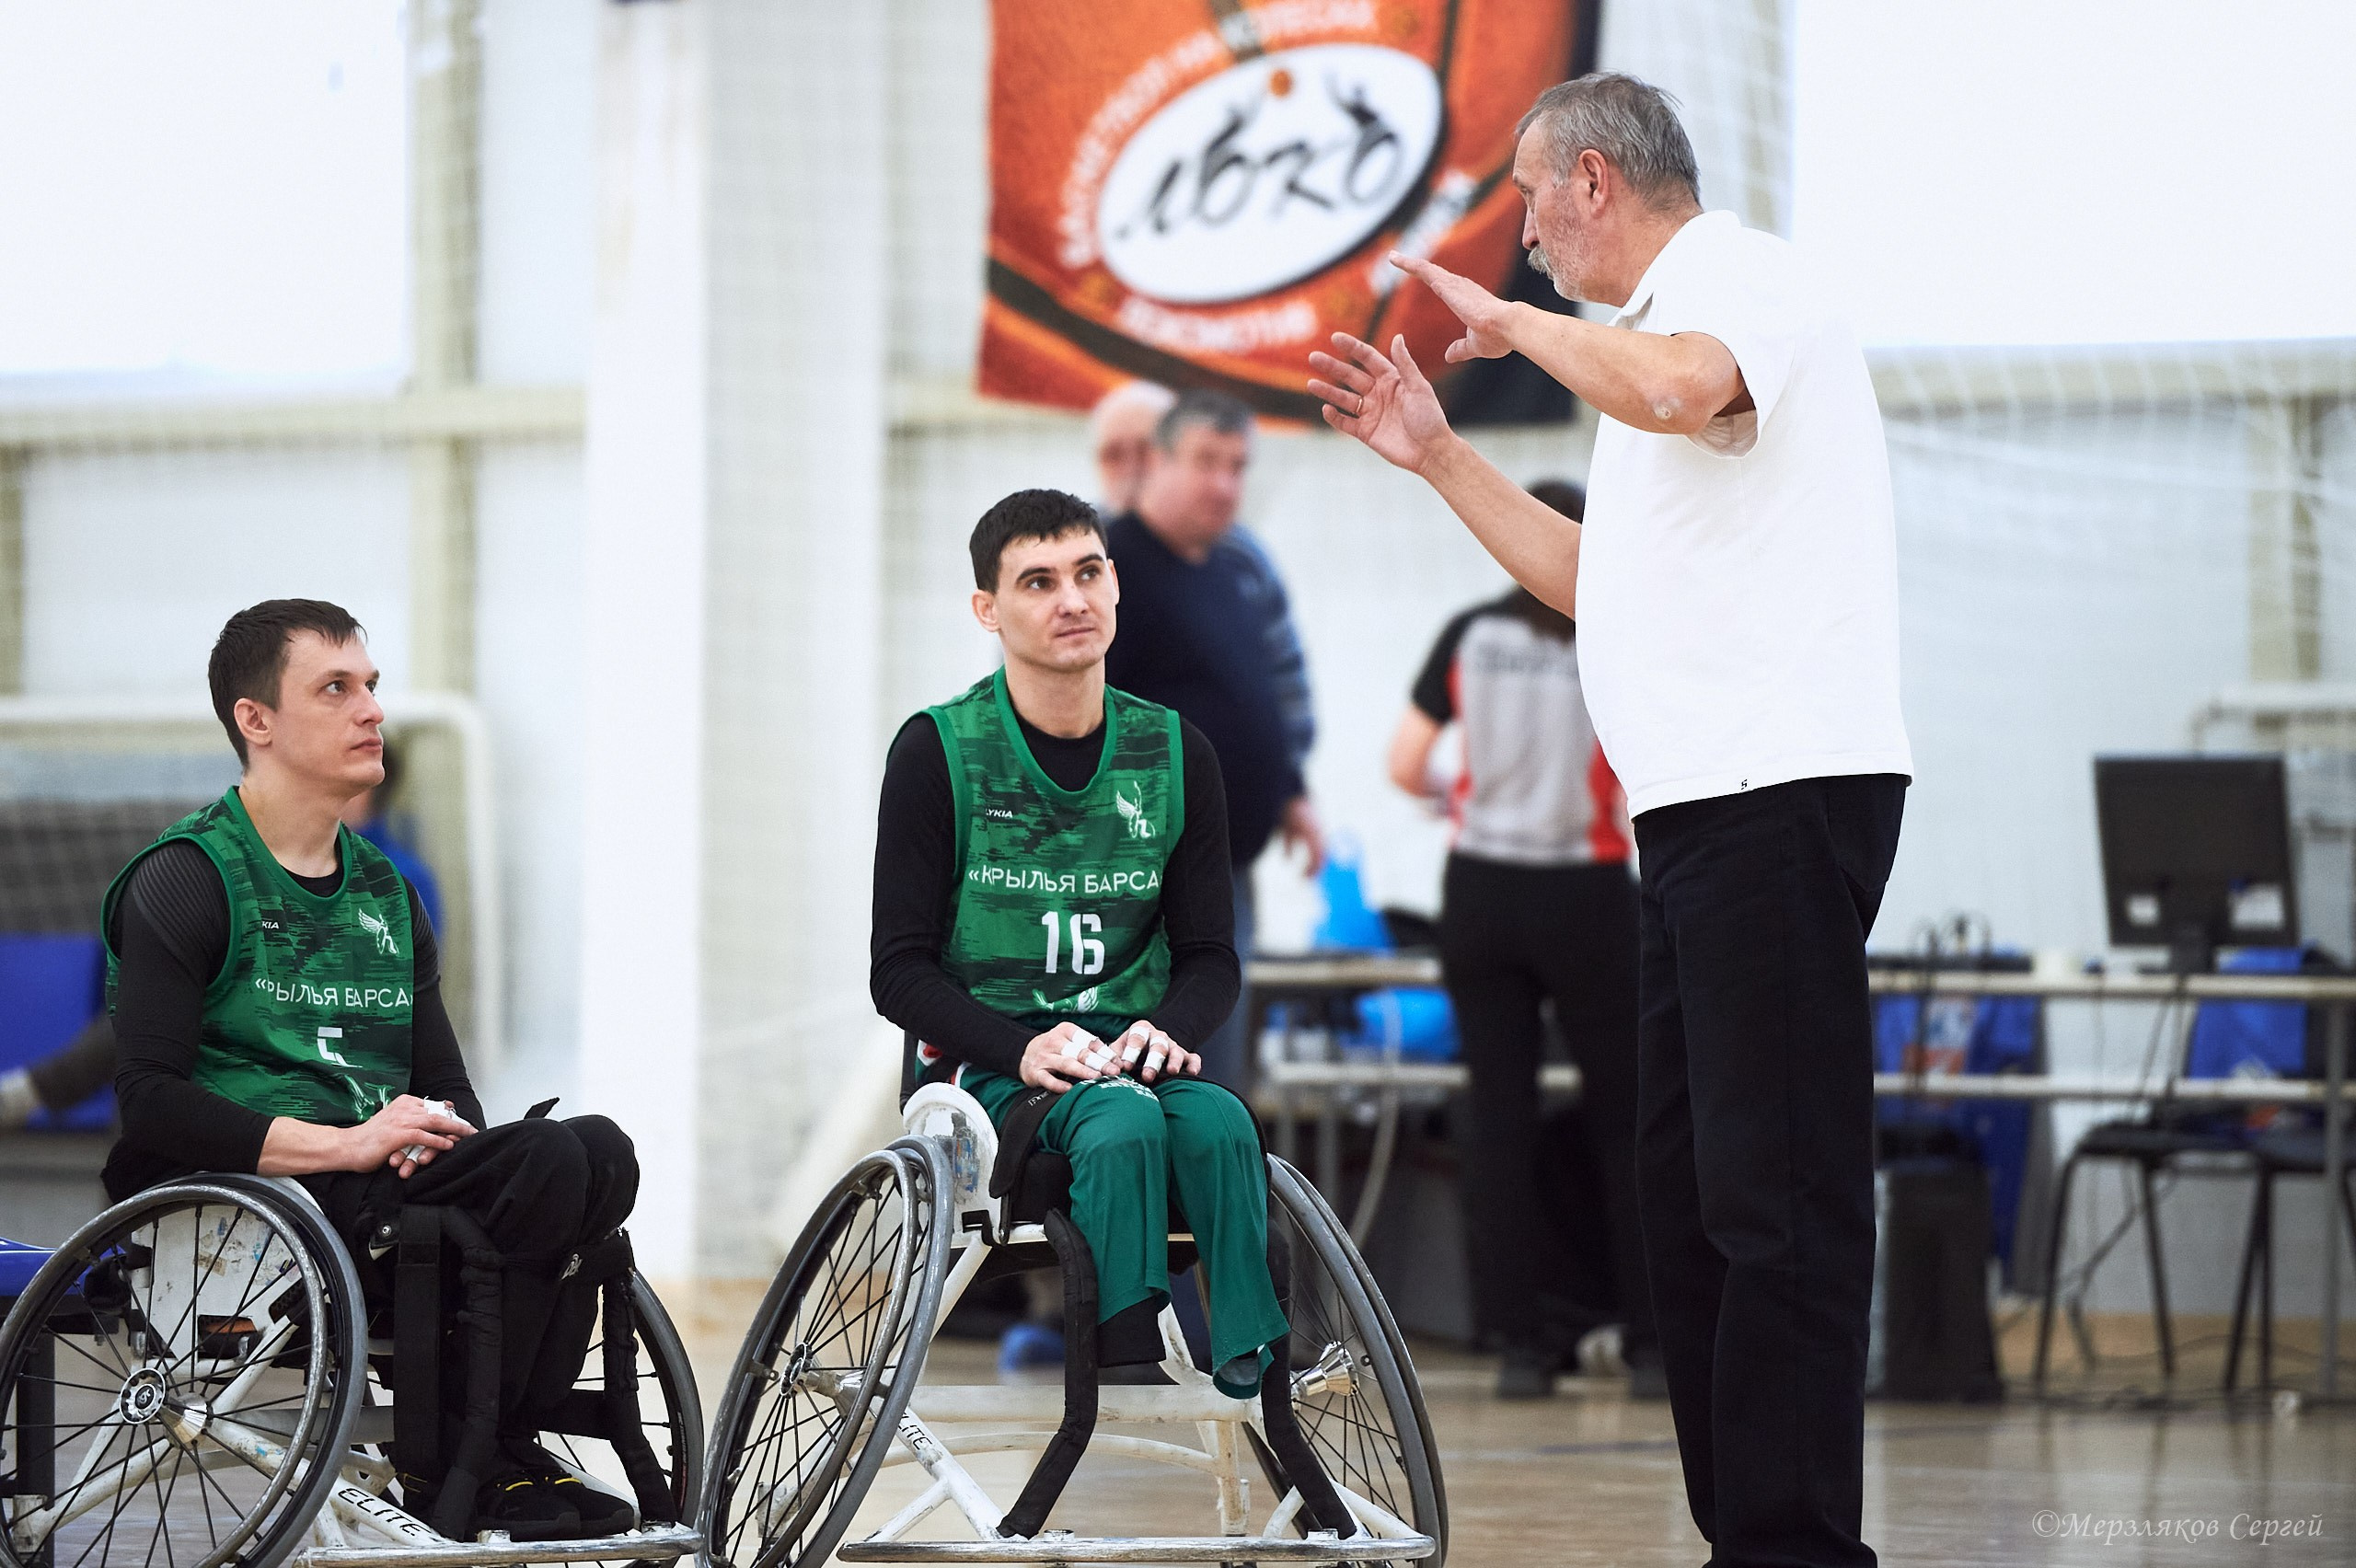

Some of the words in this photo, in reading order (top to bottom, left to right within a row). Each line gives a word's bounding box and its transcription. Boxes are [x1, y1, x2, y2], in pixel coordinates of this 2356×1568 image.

[968, 864, 1076, 893] «КРЫЛЬЯ
[1084, 870, 1163, 894] БАРСА
[1041, 910, 1105, 975] 16
[898, 1411, 933, 1450] LITE
[338, 1487, 432, 1537] ELITE
